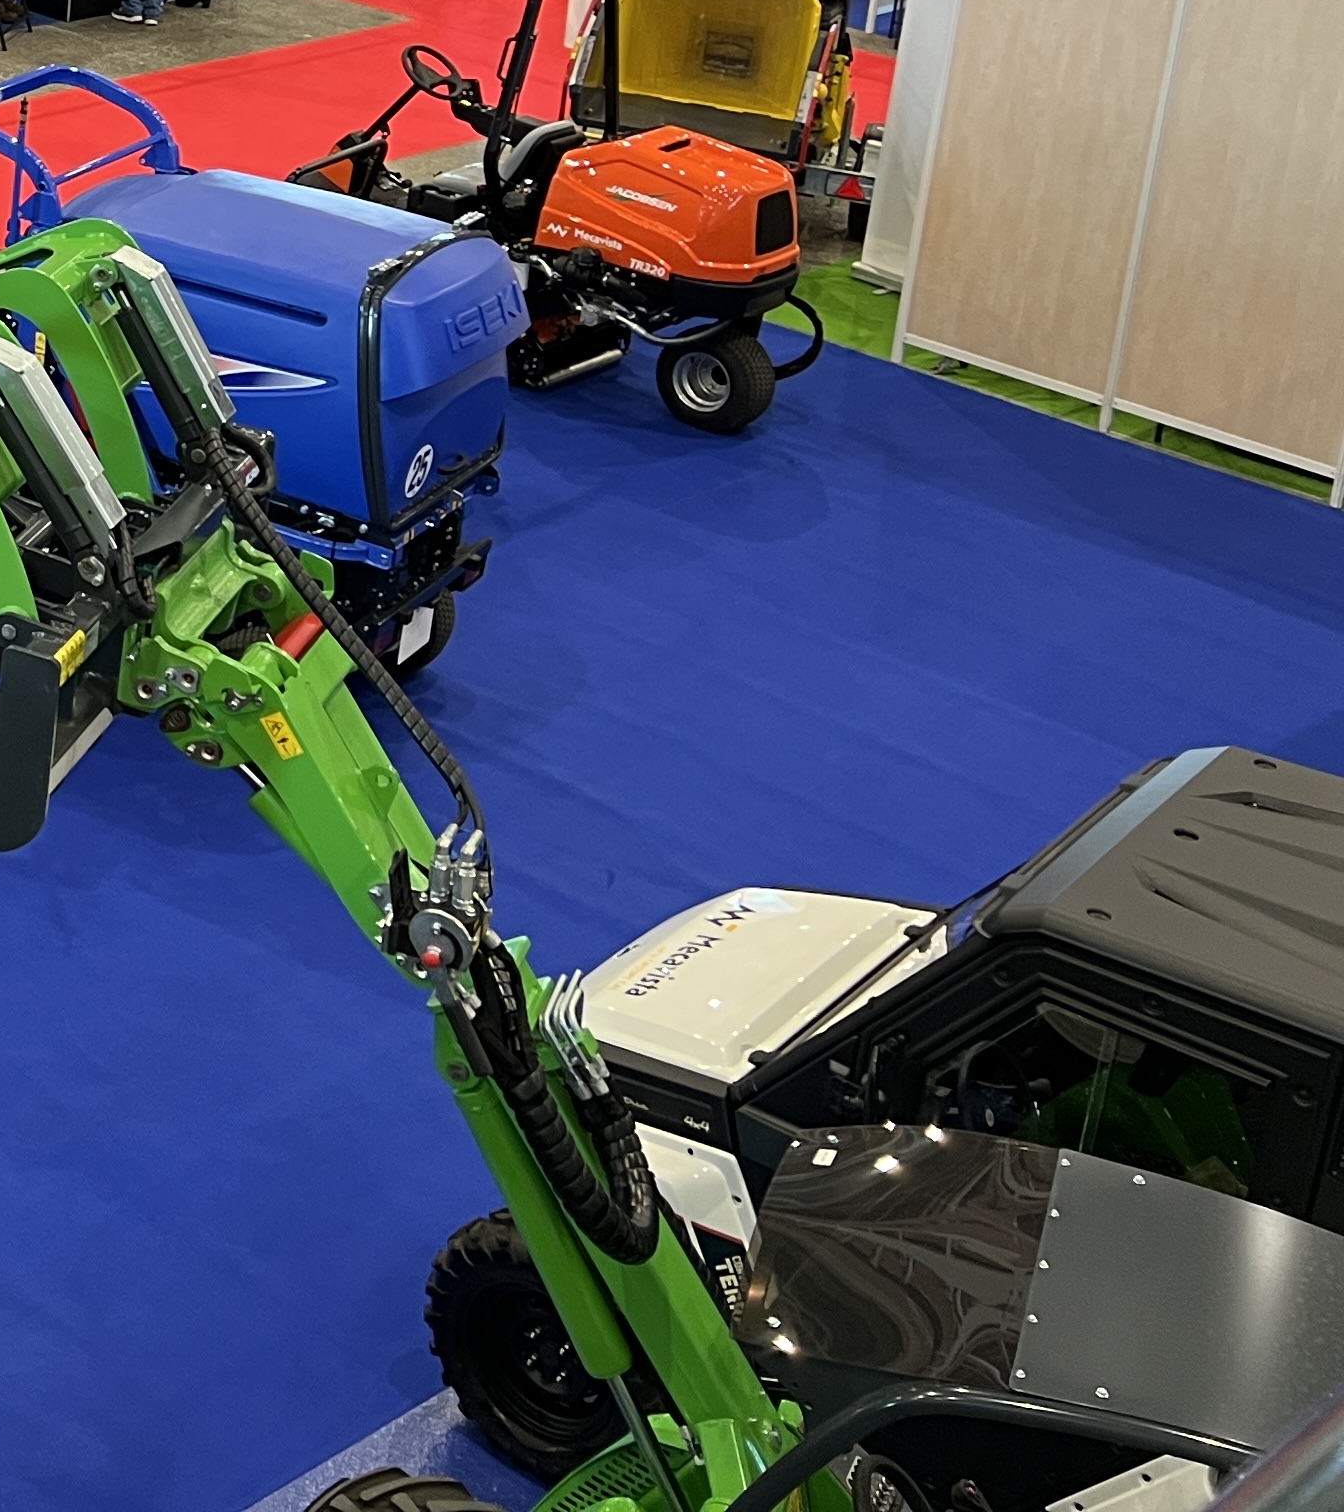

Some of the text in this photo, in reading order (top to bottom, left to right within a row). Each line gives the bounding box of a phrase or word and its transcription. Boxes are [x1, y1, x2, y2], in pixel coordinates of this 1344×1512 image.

[605, 186, 678, 213] JACOBSEN
[574, 227, 623, 251] Mecavista
[629, 257, 666, 277] TR320
[443, 280, 522, 354] ISEKI
[410, 451, 431, 491] 25
[624, 934, 724, 998] Mecavista
